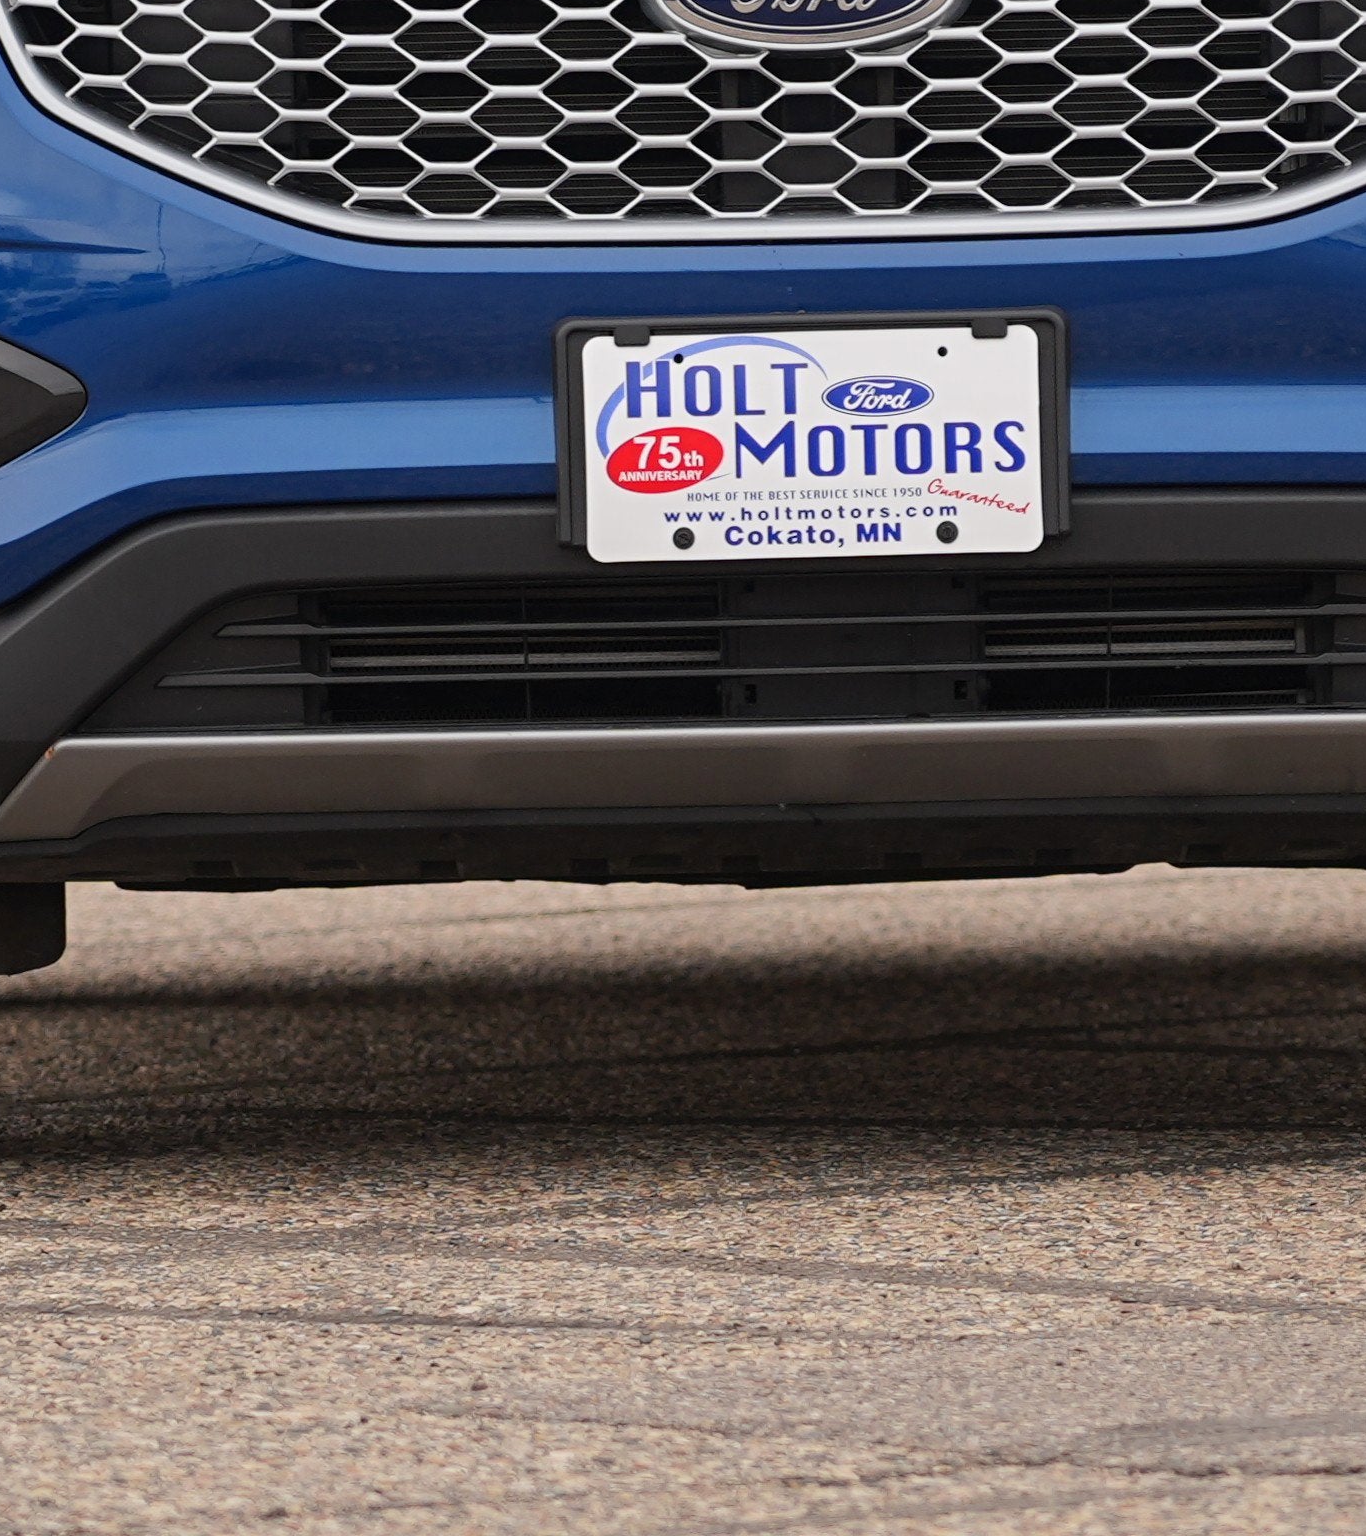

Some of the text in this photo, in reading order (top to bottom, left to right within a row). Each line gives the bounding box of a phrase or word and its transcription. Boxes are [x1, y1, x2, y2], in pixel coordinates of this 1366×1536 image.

[625, 360, 808, 419] HOLT
[843, 378, 913, 411] Ford
[633, 435, 705, 470] 75th
[734, 419, 1026, 479] MOTORS
[618, 469, 704, 482] ANNIVERSARY
[687, 486, 923, 502] HOME OF THE BEST SERVICE SINCE 1950
[927, 478, 1031, 515] Guaranteed
[663, 504, 959, 524] www.holtmotors.com
[724, 522, 903, 548] Cokato, MN
